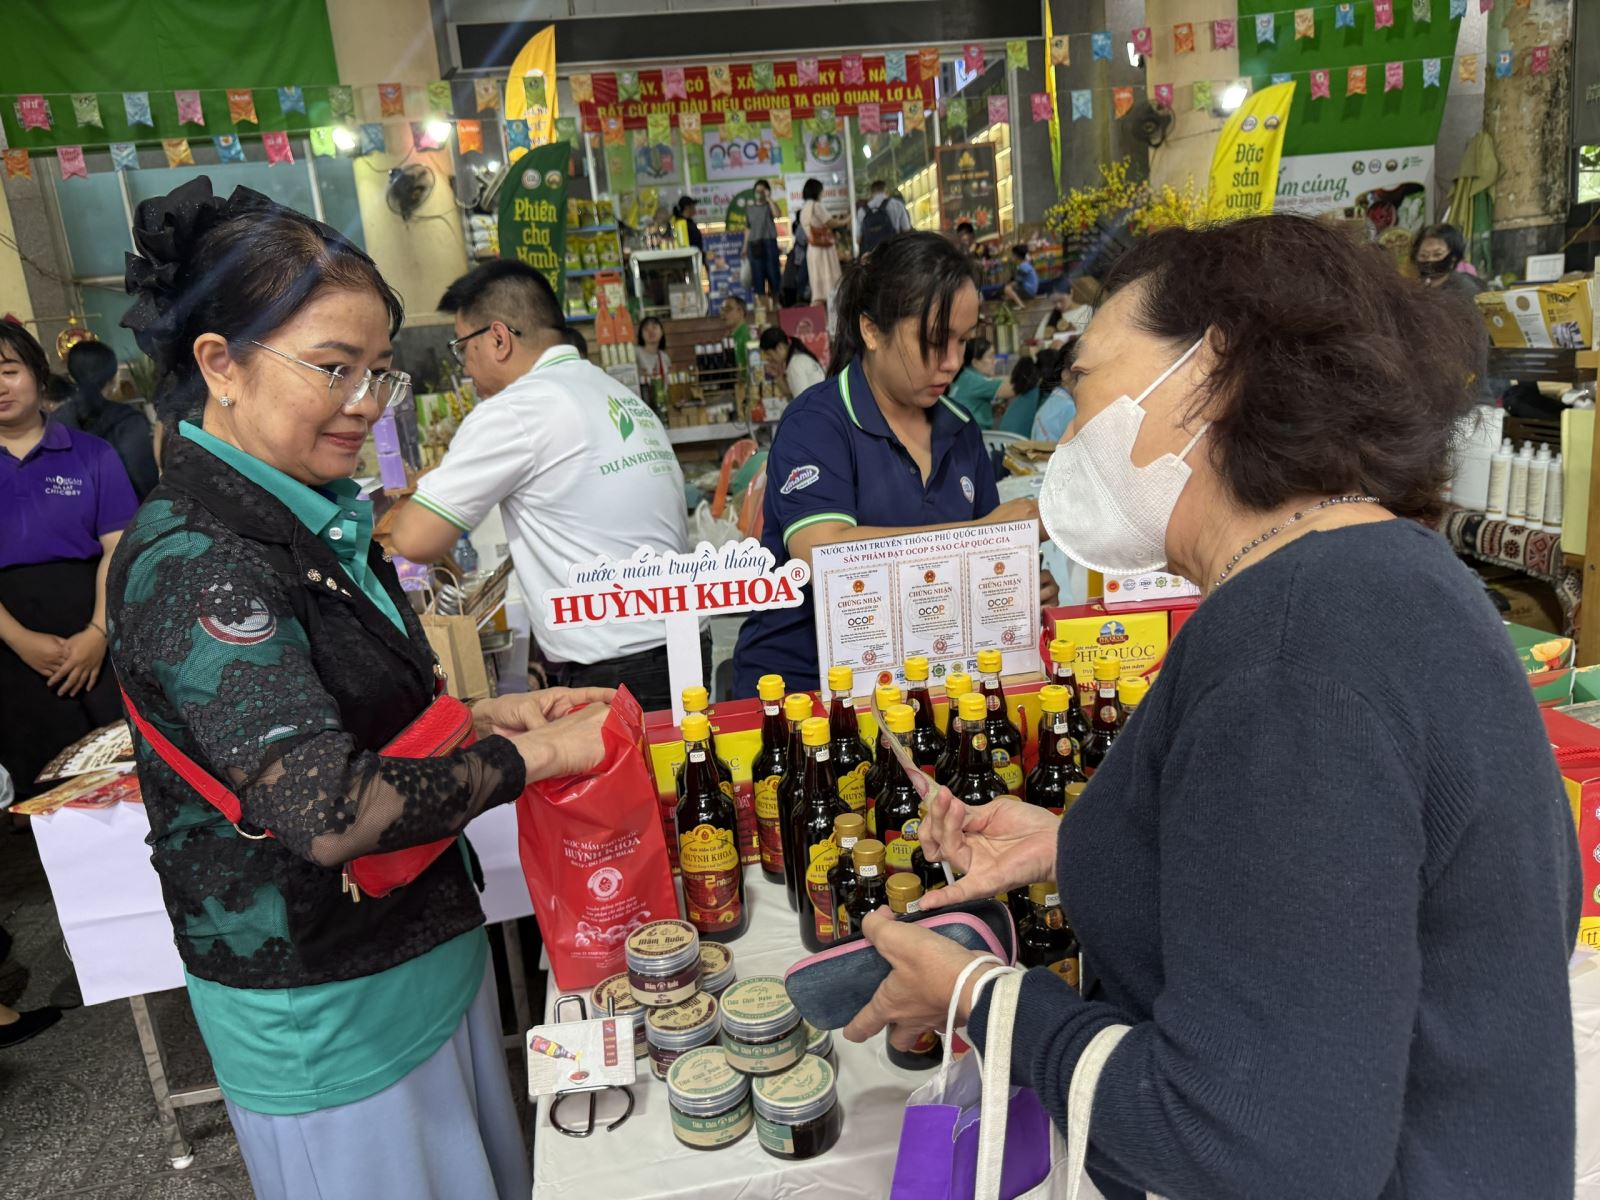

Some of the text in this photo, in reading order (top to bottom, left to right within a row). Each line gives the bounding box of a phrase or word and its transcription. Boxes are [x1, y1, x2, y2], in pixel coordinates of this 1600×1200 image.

[628, 102, 648, 117] CỨ
[744, 92, 790, 110] CHÚNG
[793, 94, 809, 107] TA
[813, 87, 840, 106] CHỦ
[844, 88, 883, 104] QUAN,
[887, 84, 903, 100] LƠ
[907, 83, 923, 99] LÀ
[1234, 143, 1264, 164] Đặc
[1233, 167, 1259, 187] sản
[1302, 174, 1350, 201] cúng
[514, 198, 557, 221] Phiên
[1226, 190, 1263, 210] vùng
[522, 223, 550, 248] chợ
[600, 460, 620, 476] DỰ
[622, 455, 639, 469] ÁN
[820, 545, 845, 556] NƯỚC
[847, 543, 867, 553] MẮM
[869, 538, 902, 551] TRUYỀN
[904, 534, 933, 546] THỐNG
[935, 531, 952, 541] PHÚ
[952, 528, 977, 540] QUỐC
[1008, 522, 1032, 532] KHOA
[843, 552, 861, 564] SẢN
[861, 550, 886, 562] PHẨM
[887, 548, 905, 559] ĐẠT
[905, 546, 929, 556] OCOP
[936, 543, 952, 552] SAO
[953, 539, 970, 550] CẤP
[971, 536, 995, 548] QUỐC
[996, 536, 1010, 544] GIA
[576, 545, 768, 583] nước mắm truyền thống
[550, 583, 688, 624] HUỲNH
[693, 576, 797, 610] KHOA
[908, 588, 932, 599] CHỨNG
[933, 585, 953, 596] NHẬN
[987, 596, 1014, 607] OCOP
[838, 597, 862, 609] CHỨNG
[918, 604, 945, 616] OCOP
[848, 614, 874, 626] OCOP
[1105, 642, 1156, 660] QUỐC
[564, 837, 641, 862] HUỲNH KHOA
